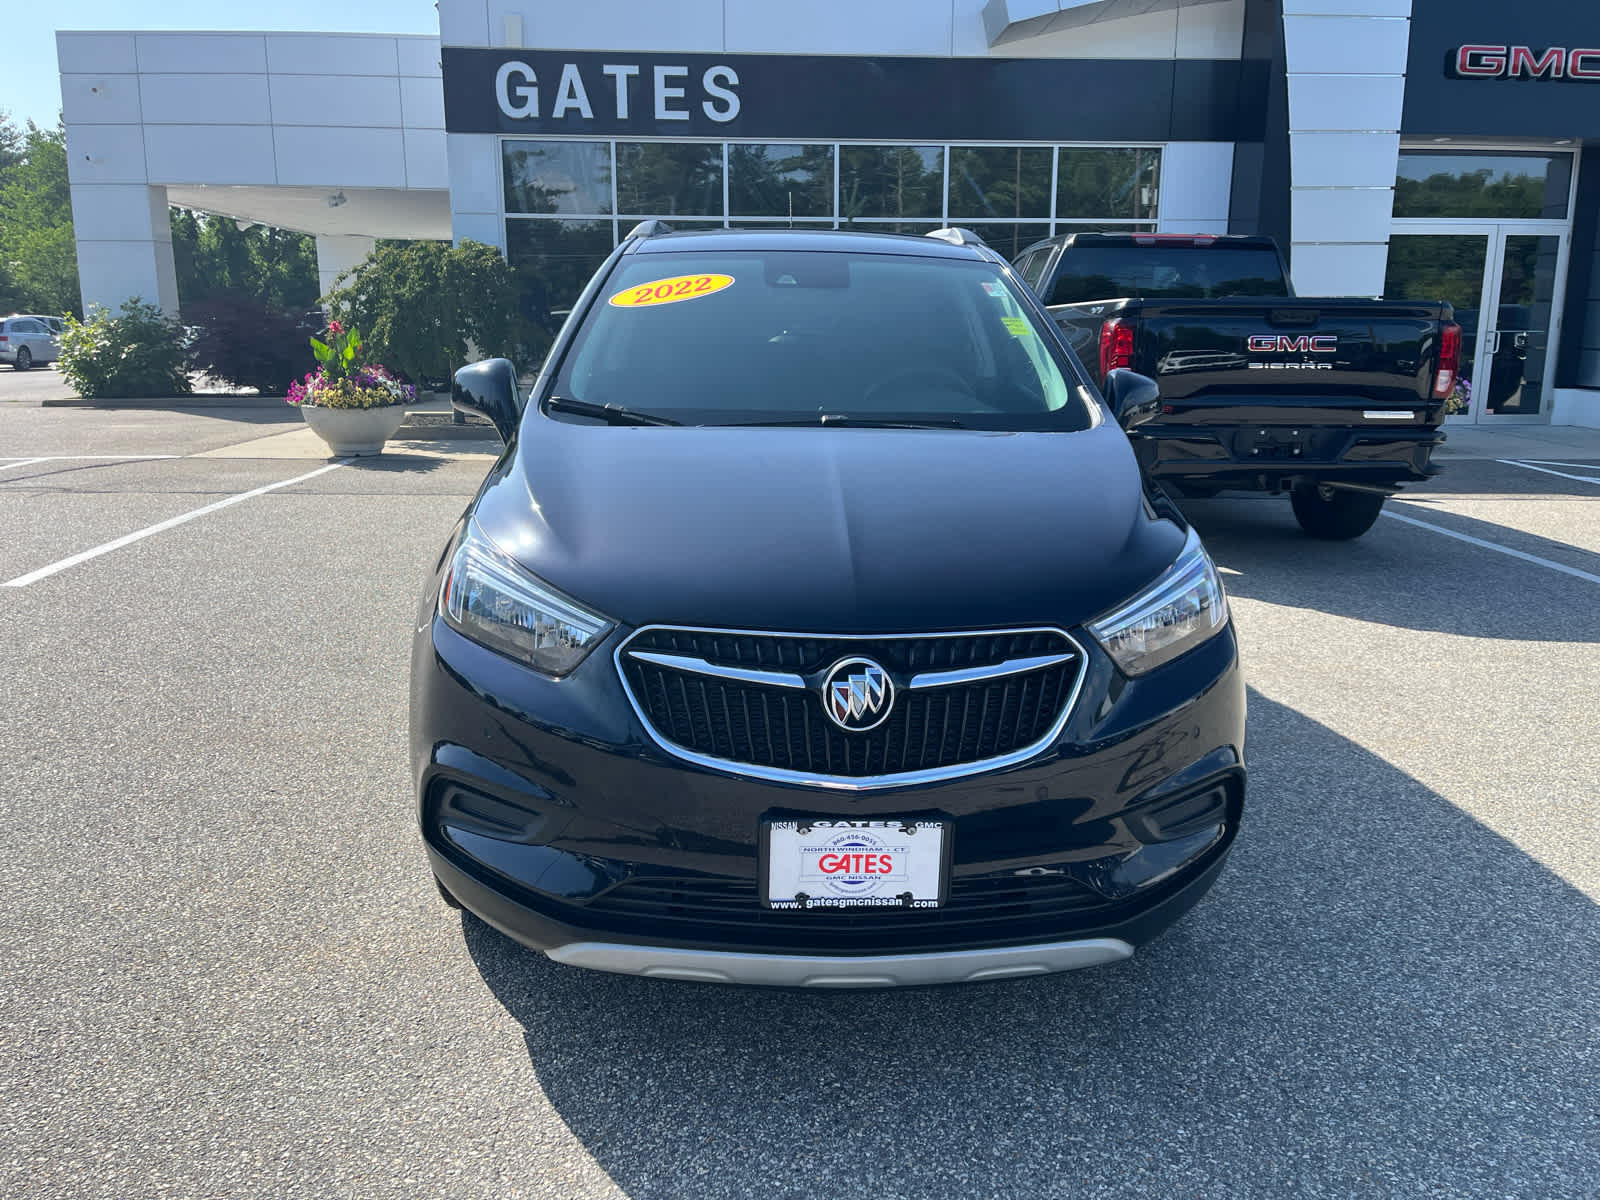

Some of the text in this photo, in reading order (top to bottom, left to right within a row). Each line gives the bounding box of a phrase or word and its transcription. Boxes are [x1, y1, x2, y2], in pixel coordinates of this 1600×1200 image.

[1456, 44, 1600, 79] GMC
[495, 60, 741, 122] GATES
[633, 277, 713, 304] 2022
[1247, 335, 1338, 353] GMC
[1247, 362, 1333, 370] SIERRA
[770, 820, 944, 831] NISSAN GATES GMC
[818, 853, 893, 875] GATES
[806, 896, 903, 908] gatesgmcnissan
